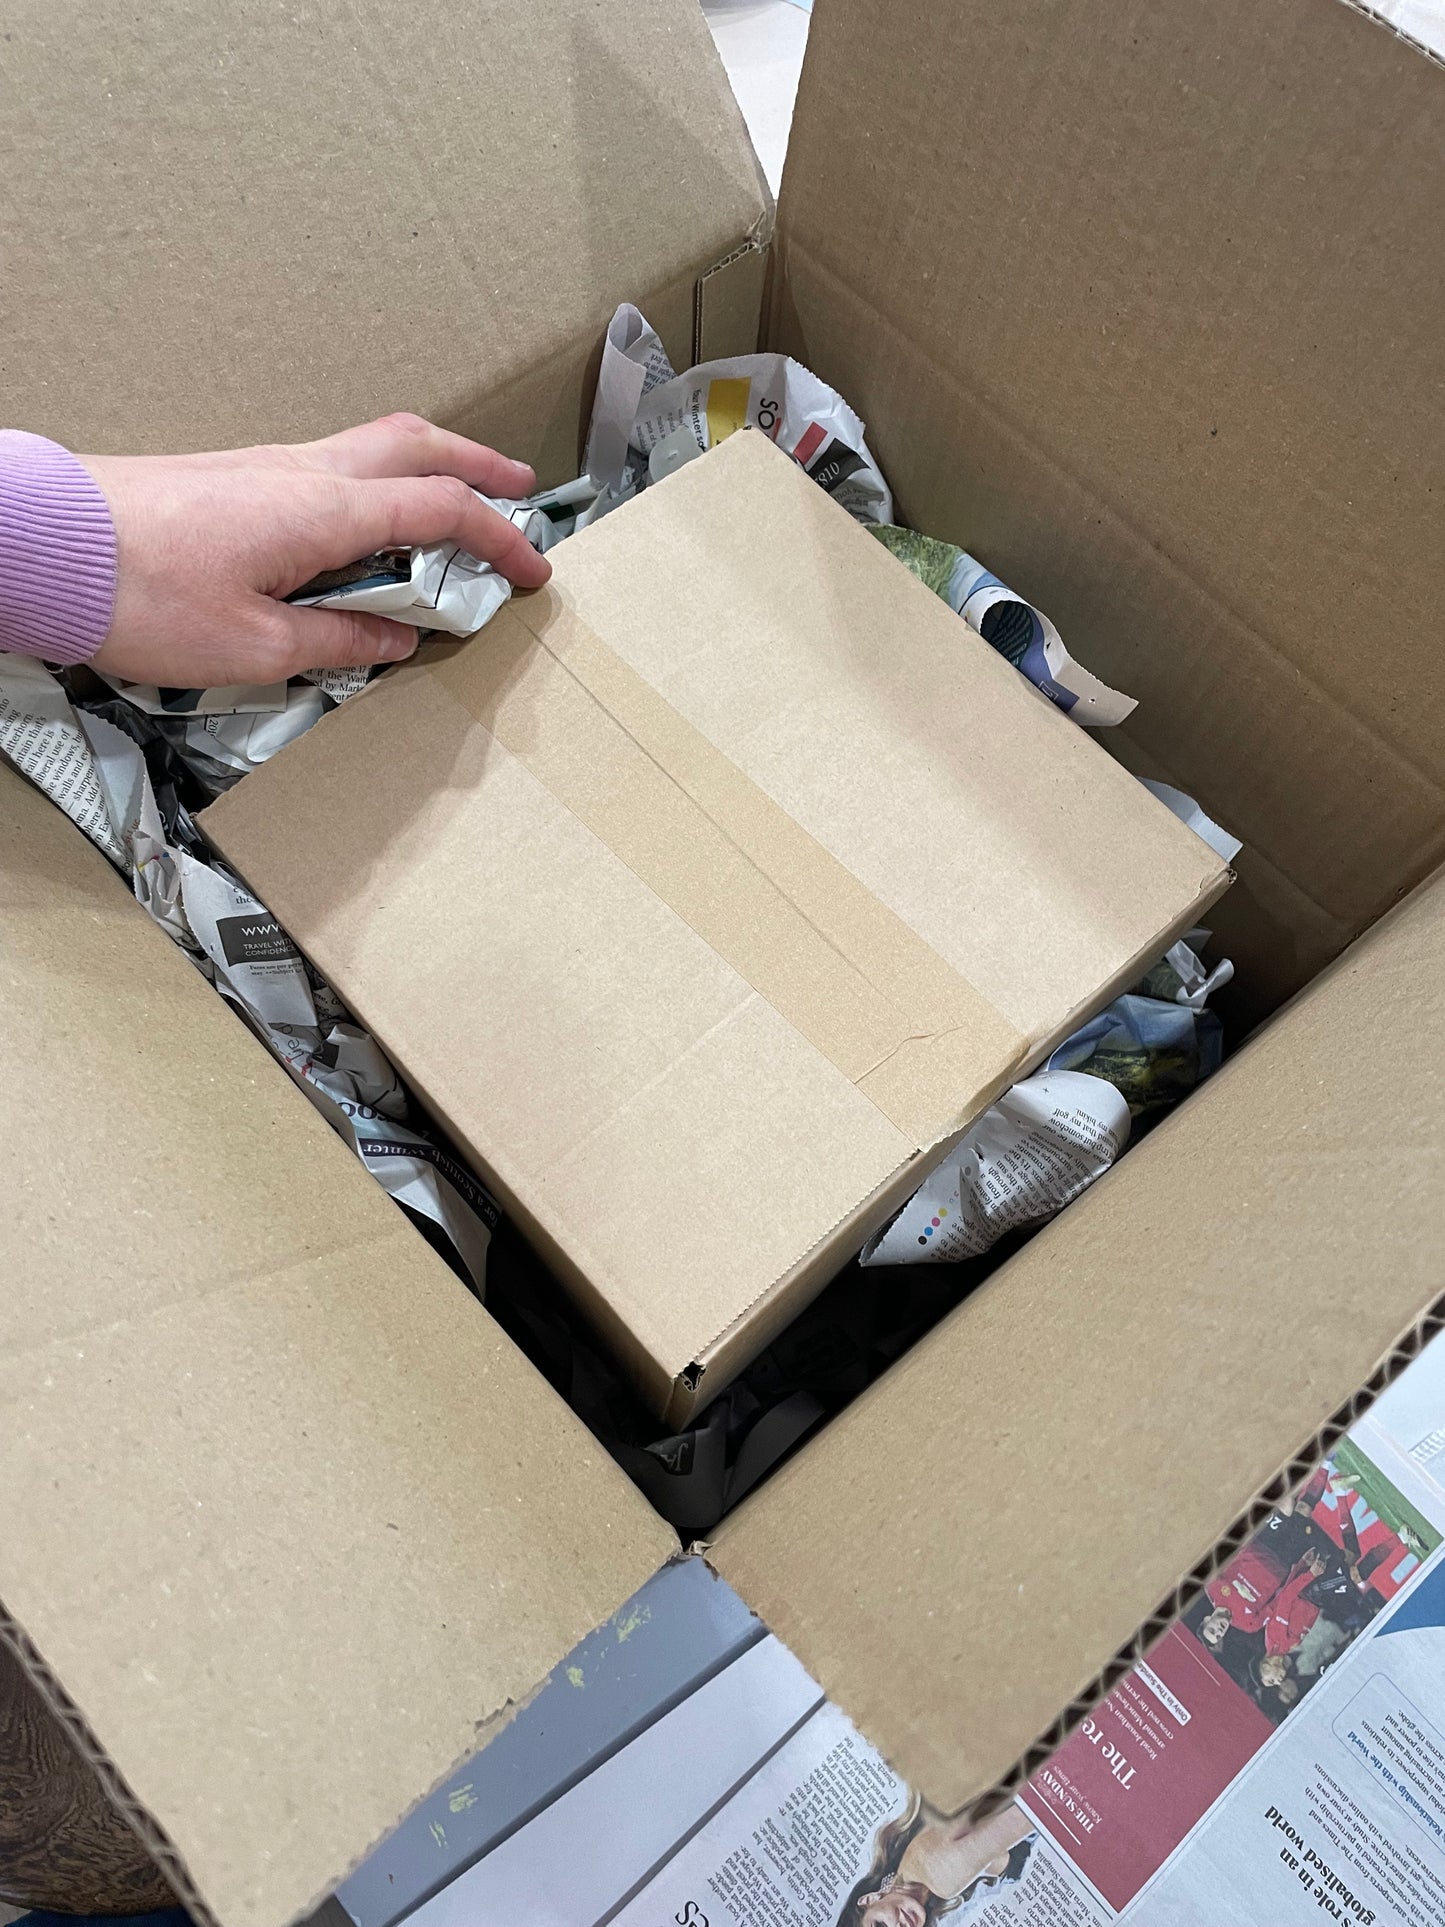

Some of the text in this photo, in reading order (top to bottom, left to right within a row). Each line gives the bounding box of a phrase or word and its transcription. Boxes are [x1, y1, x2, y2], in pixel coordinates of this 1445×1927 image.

[689, 403, 702, 433] Winter
[325, 680, 336, 691] by
[327, 670, 342, 680] the
[31, 729, 54, 758] here is
[32, 728, 70, 784] liberal use of
[52, 743, 80, 781] windows,
[56, 759, 84, 799] walls and
[84, 786, 98, 806] Add
[1048, 1116, 1109, 1160] trip but somehow
[1052, 1107, 1097, 1137] that my golf
[1056, 1133, 1067, 1142] be
[364, 1143, 423, 1156] winter
[998, 1153, 1019, 1172] hues
[1008, 1149, 1021, 1160] the
[1013, 1143, 1055, 1183] the romantic
[1067, 1139, 1088, 1155] might
[429, 1149, 476, 1199] Scottish
[986, 1166, 1011, 1196] through
[995, 1159, 1008, 1174] sun
[1005, 1172, 1018, 1186] the
[1036, 1152, 1068, 1180] Perhaps
[972, 1179, 993, 1205] feature
[981, 1180, 1001, 1199] from
[479, 1207, 498, 1227] for
[1137, 1699, 1149, 1712] the
[1155, 1683, 1188, 1721] Only in The
[1113, 1709, 1157, 1760] Read Jonathan
[1141, 1723, 1165, 1748] around
[1384, 1714, 1435, 1768] rise to power and
[1397, 1709, 1445, 1761] across the globe.
[843, 1736, 885, 1788] wounded the
[1099, 1741, 1137, 1790] The
[1361, 1720, 1429, 1796] superpower, its relations
[1380, 1725, 1443, 1793] an increasing amount
[836, 1768, 866, 1805] forgiveness
[849, 1758, 890, 1807] was not truthful
[1053, 1765, 1070, 1786] times
[1316, 1782, 1330, 1798] own
[1347, 1730, 1445, 1836] Relationship with the World
[827, 1785, 861, 1825] gestures and
[853, 1775, 885, 1815] certain parts
[1039, 1769, 1094, 1833] THE SUNDAY
[1068, 1784, 1087, 1802] your
[1329, 1797, 1346, 1815] your
[794, 1786, 845, 1849] welcomed back into
[1313, 1762, 1422, 1881] get involved with online discussions
[1343, 1813, 1352, 1822] at
[1350, 1821, 1370, 1843] Study
[809, 1819, 856, 1877] nouncement that
[1304, 1786, 1425, 1922] with courses created in partnership with
[1307, 1809, 1407, 1918] and experts from The Times and
[1404, 1844, 1421, 1865] tests.
[755, 1865, 772, 1885] ready
[765, 1834, 819, 1903] defrocked after police
[797, 1846, 839, 1899] women to rough
[1263, 1805, 1376, 1927] globalised world
[706, 1877, 741, 1921] local mother
[1012, 1890, 1024, 1904] has
[1025, 1877, 1058, 1917] always been
[1029, 1870, 1062, 1909] towards him
[1032, 1859, 1084, 1921] are satisfied with
[1057, 1877, 1075, 1898] Elena
[1279, 1847, 1343, 1920] role in an
[1405, 1880, 1436, 1914] provider,
[774, 1907, 792, 1925] good
[1032, 1902, 1046, 1916] and
[1072, 1894, 1090, 1916] Maria
